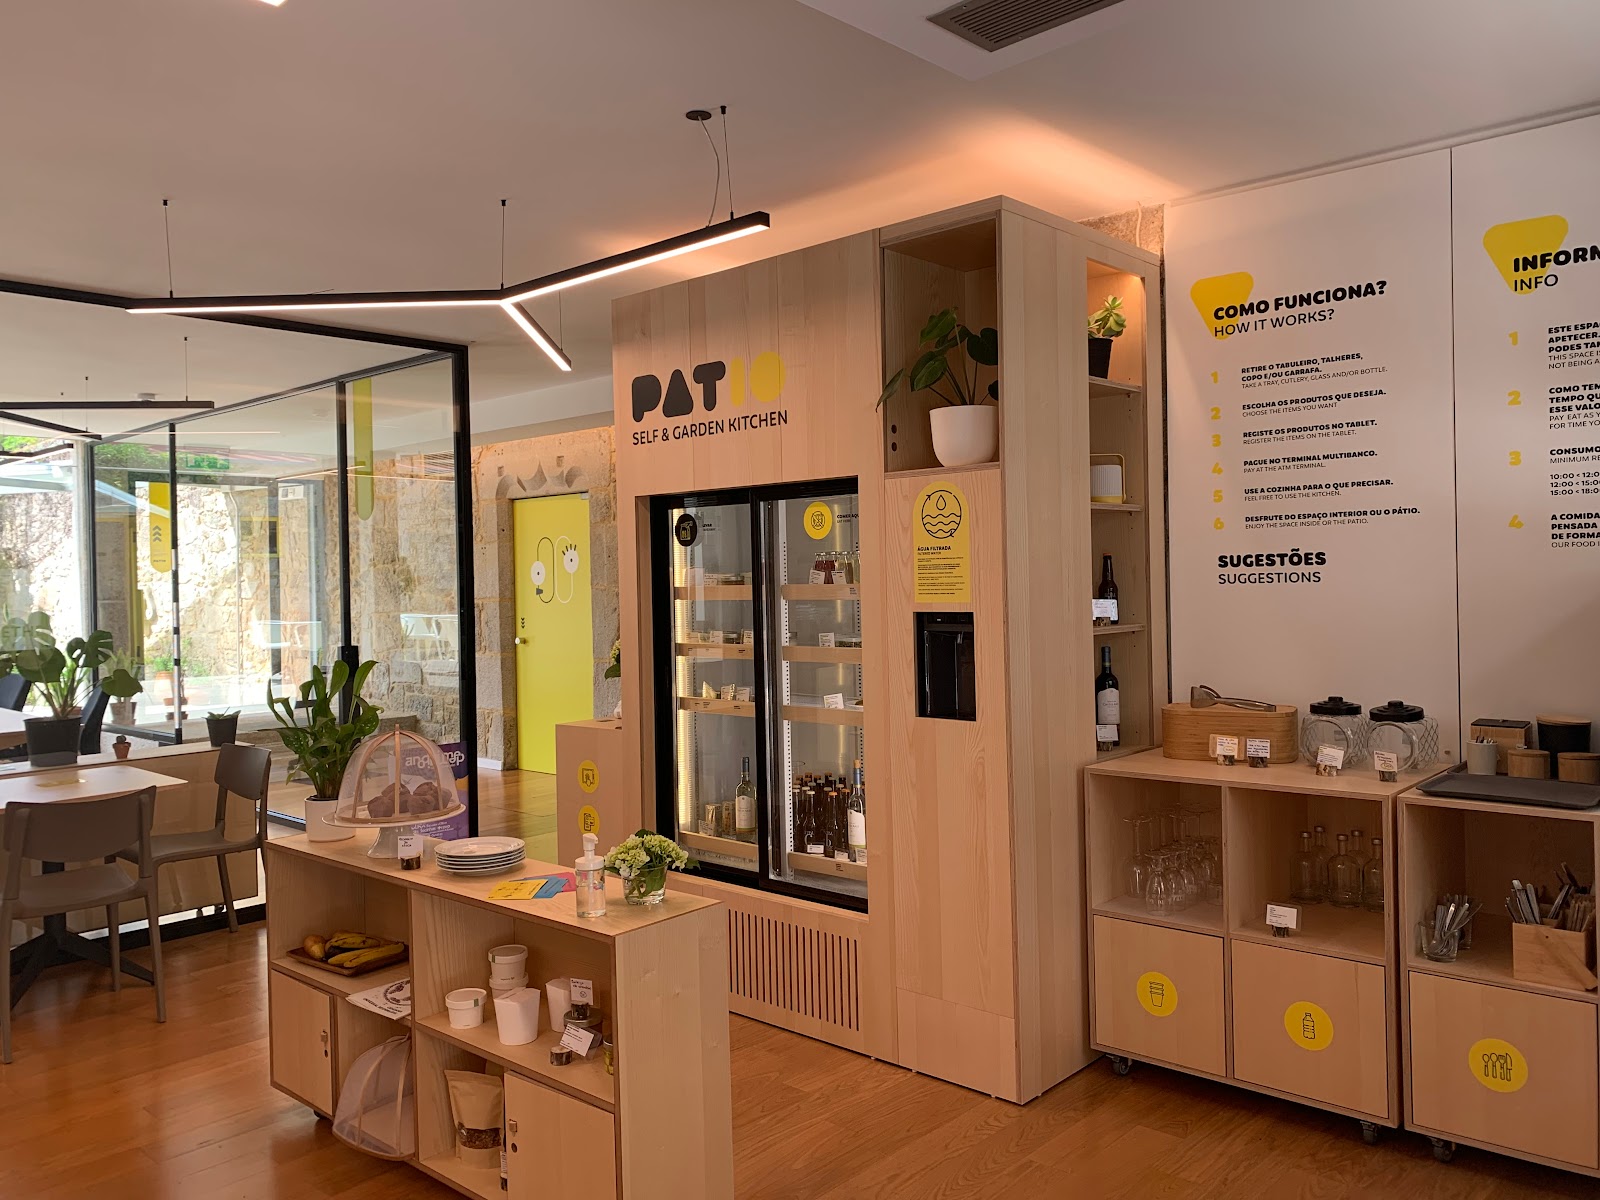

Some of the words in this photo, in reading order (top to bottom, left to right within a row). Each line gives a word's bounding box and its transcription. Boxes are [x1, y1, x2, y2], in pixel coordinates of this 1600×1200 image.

[1514, 274, 1558, 292] INFO
[1214, 298, 1269, 321] COMO
[1274, 280, 1387, 312] FUNCIONA?
[1214, 321, 1250, 337] HOW
[1254, 319, 1267, 332] IT
[1270, 309, 1334, 329] WORKS?
[1548, 325, 1572, 334] ESTE
[1574, 322, 1600, 330] ESPA
[1508, 331, 1518, 346] 1
[1549, 343, 1582, 353] PODES
[1569, 351, 1594, 359] SPACE
[1241, 365, 1266, 374] RETIRE
[1276, 358, 1320, 370] TABULEIRO,
[1321, 353, 1363, 365] TALHERES,
[1568, 359, 1592, 367] BEING
[1211, 371, 1218, 384] 1
[1241, 374, 1262, 382] COPO
[1264, 371, 1283, 379] E/OU
[1284, 367, 1322, 377] GARRAFA.
[1281, 376, 1309, 384] CUTLERY,
[1332, 370, 1359, 378] AND/OR
[1360, 367, 1388, 375] BOTTLE.
[632, 351, 786, 422] PATIO
[1549, 385, 1579, 394] COMO
[1242, 401, 1276, 410] ESCOLHA
[1290, 395, 1333, 405] PRODUTOS
[1335, 393, 1352, 402] QUE
[1353, 389, 1386, 399] DESEJA.
[1507, 390, 1522, 406] 2
[1549, 395, 1584, 403] TEMPO
[1210, 407, 1221, 420] 2
[1242, 409, 1268, 417] CHOOSE
[632, 429, 658, 445] SELF
[661, 428, 670, 441] &
[672, 419, 724, 440] GARDEN
[728, 410, 788, 432] KITCHEN
[1243, 429, 1273, 438] REGISTE
[1287, 424, 1330, 434] PRODUTOS
[1345, 420, 1377, 428] TABLET.
[1212, 434, 1221, 447] 3
[1282, 454, 1321, 463] TERMINAL
[1323, 450, 1378, 460] MULTIBANCO.
[1509, 451, 1522, 466] 3
[1212, 462, 1223, 475] 4
[1266, 485, 1302, 493] COZINHA
[1333, 482, 1350, 490] QUE
[1351, 479, 1394, 488] PRECISAR.
[1213, 490, 1223, 503] 5
[1298, 512, 1328, 520] ESPAÇO
[1392, 506, 1420, 515] PÁTIO.
[1214, 517, 1224, 530] 6
[1508, 514, 1524, 529] 4
[1218, 548, 1326, 568] SUGESTÕES
[1218, 572, 1321, 584] SUGGESTIONS
